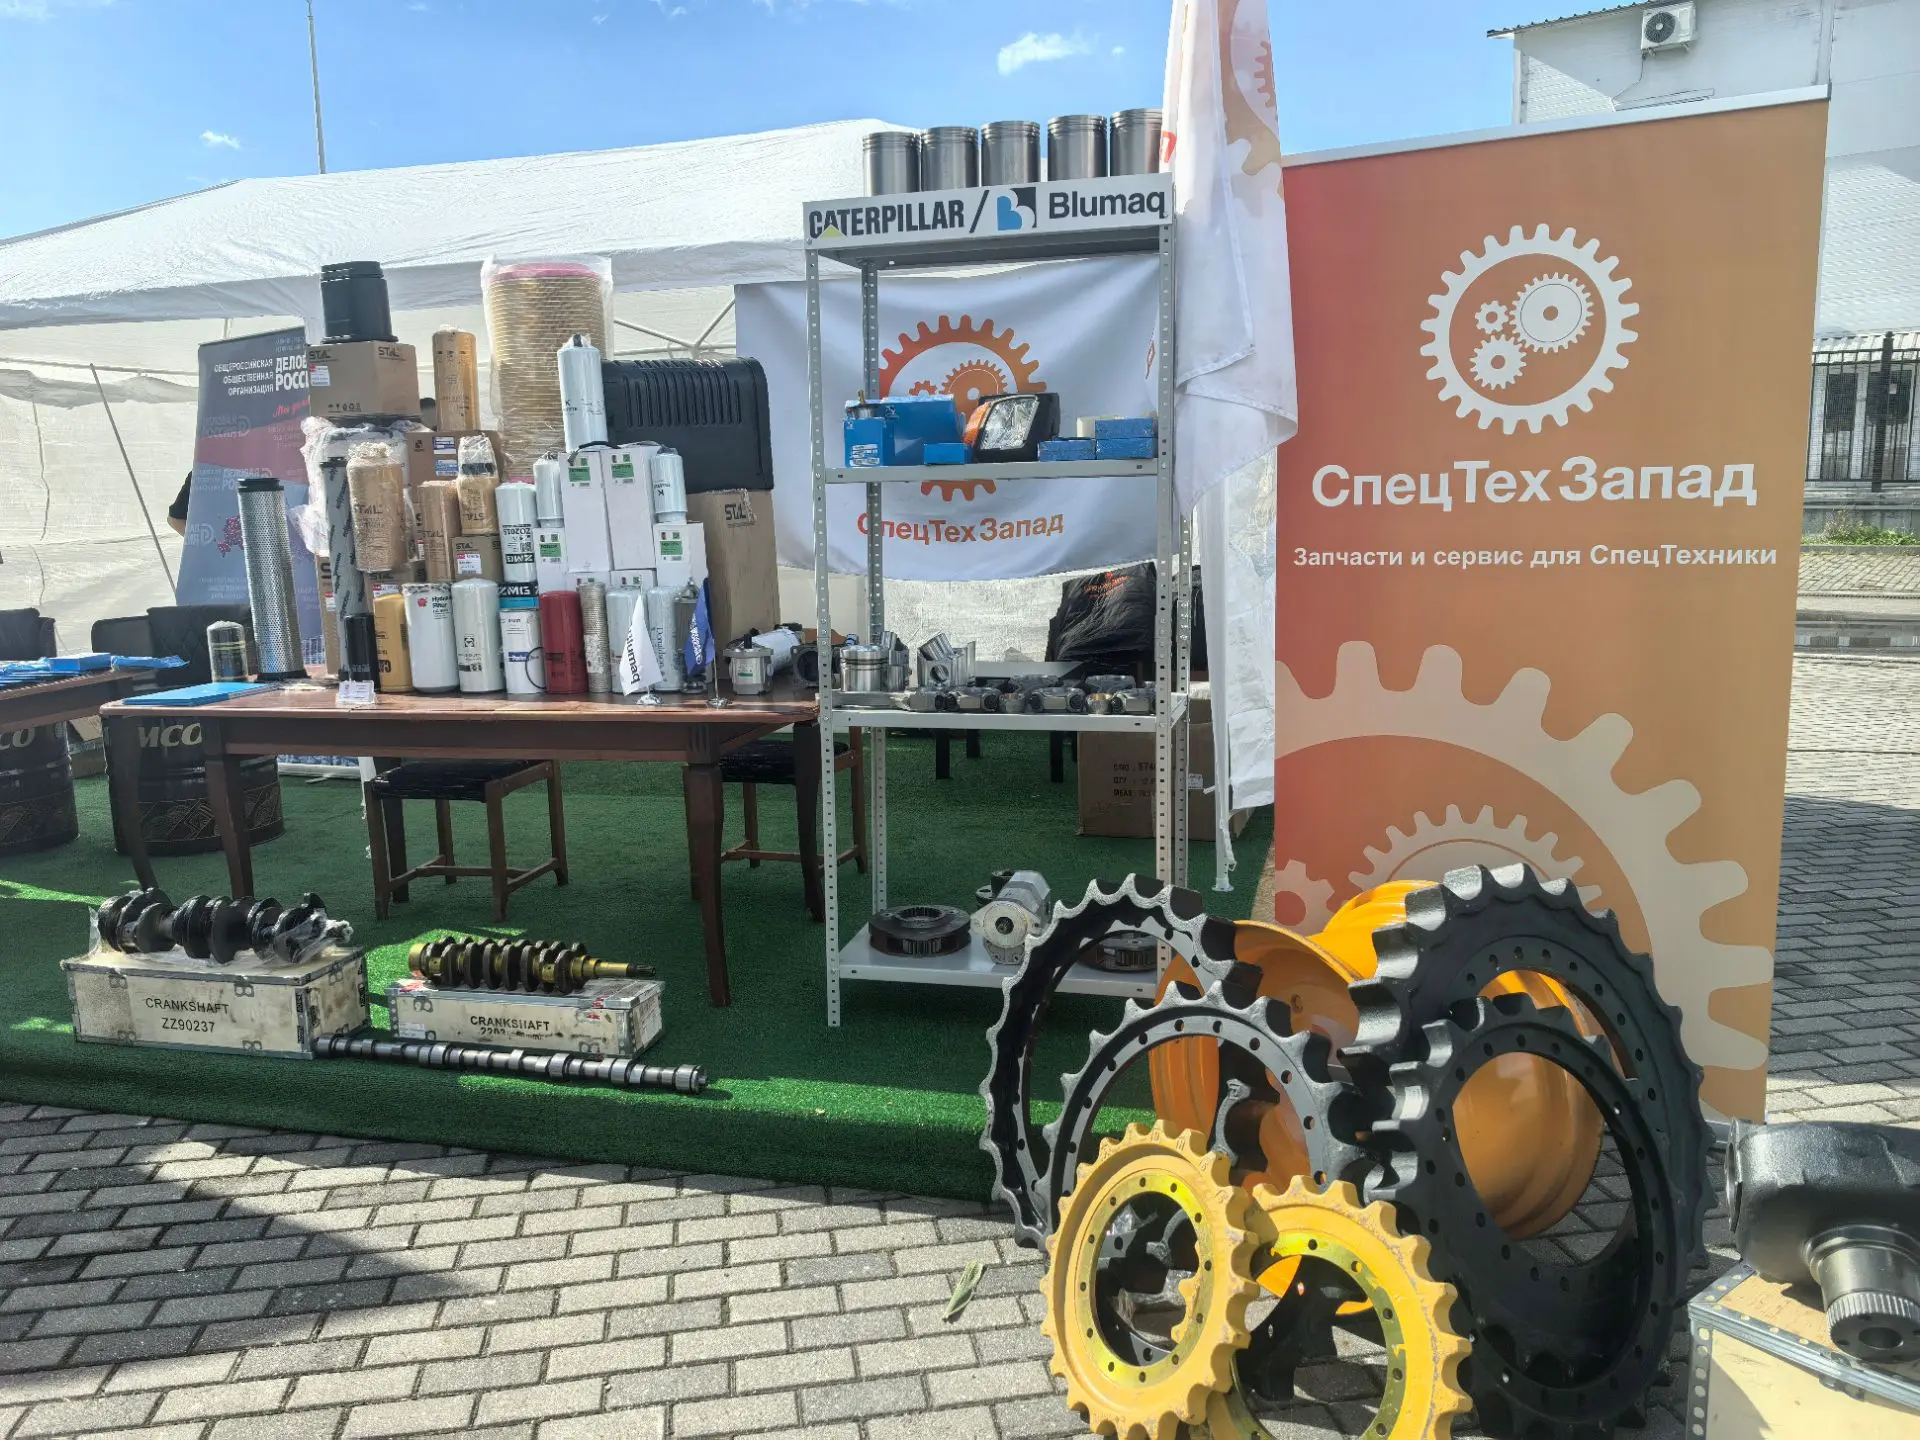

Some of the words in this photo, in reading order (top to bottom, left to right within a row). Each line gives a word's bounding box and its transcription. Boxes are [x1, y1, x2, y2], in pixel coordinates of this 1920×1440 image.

[809, 199, 965, 240] CATERPILLAR
[1048, 189, 1166, 219] Blumaq
[1293, 547, 1404, 567] Запчасти
[1410, 549, 1426, 566] и
[1433, 547, 1523, 570] сервис
[1531, 548, 1581, 568] для
[1590, 544, 1777, 569] СпецТехники
[145, 996, 230, 1015] CRANKSHAFT
[161, 1017, 215, 1033] ZZ90237
[470, 1015, 550, 1032] CRANKSHAFT
